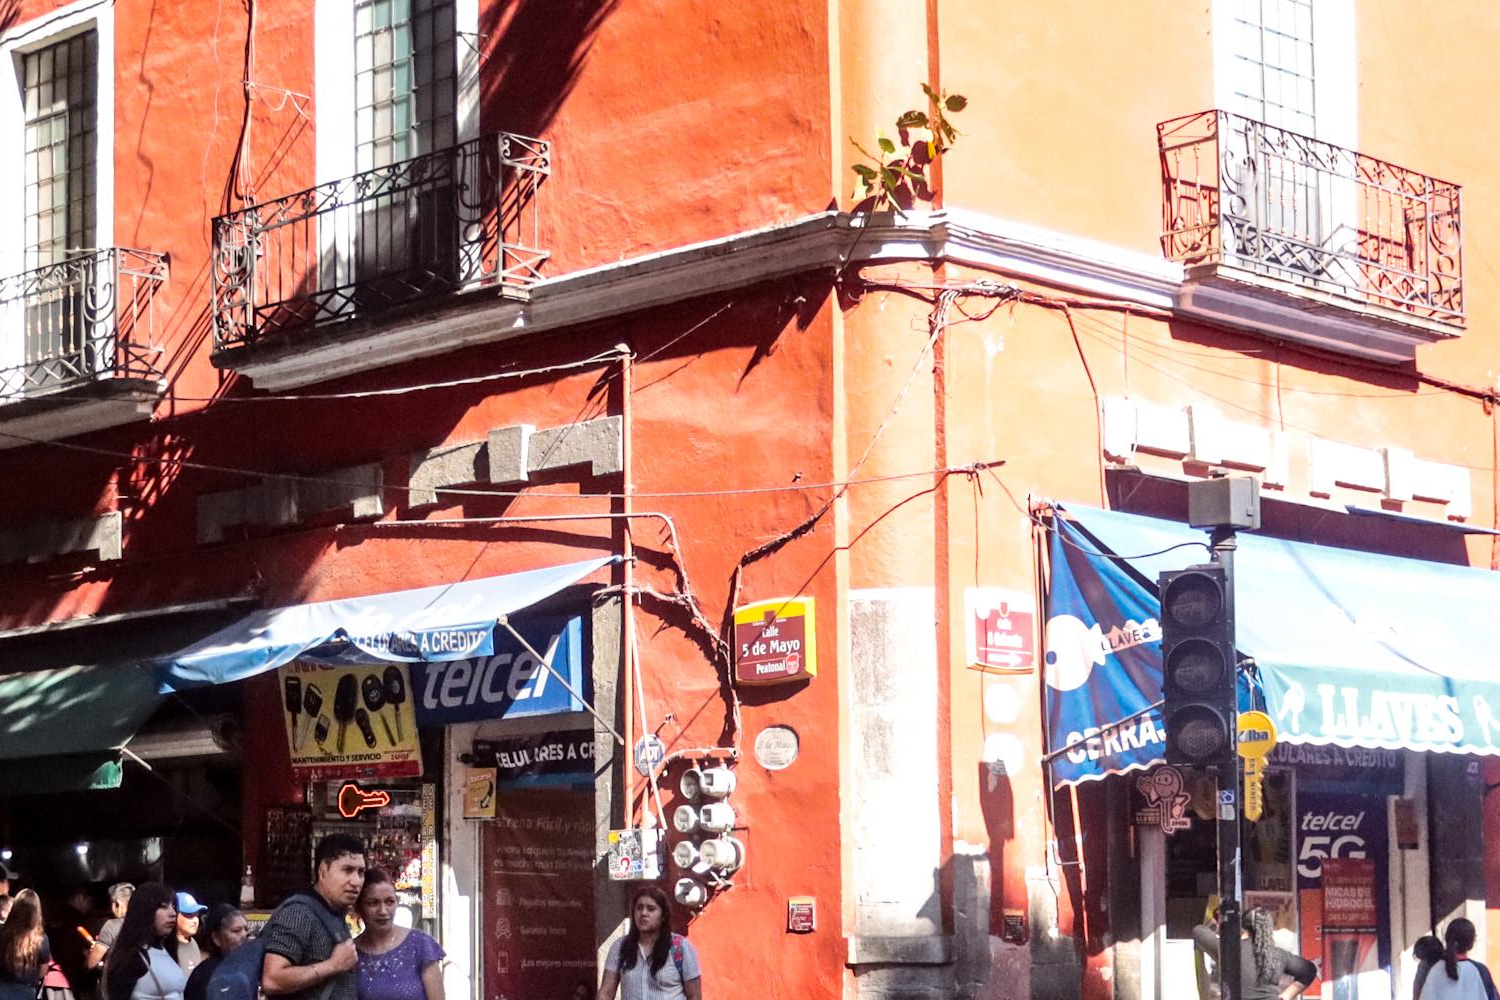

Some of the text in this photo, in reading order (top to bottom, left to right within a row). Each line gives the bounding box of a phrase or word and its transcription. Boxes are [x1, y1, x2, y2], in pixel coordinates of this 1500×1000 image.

[762, 626, 779, 638] Calle
[421, 631, 430, 652] A
[742, 640, 800, 657] 5 de Mayo
[424, 635, 559, 710] telcel
[756, 660, 786, 674] Peatonal
[1318, 684, 1463, 742] LLAVES
[1066, 713, 1167, 764] CERRA
[292, 755, 344, 764] MANTENIMIENTO
[351, 753, 381, 762] SERVICIO
[567, 744, 577, 760] A
[1301, 811, 1365, 830] telcel
[1297, 835, 1366, 878] 5G
[1357, 887, 1372, 898] DE
